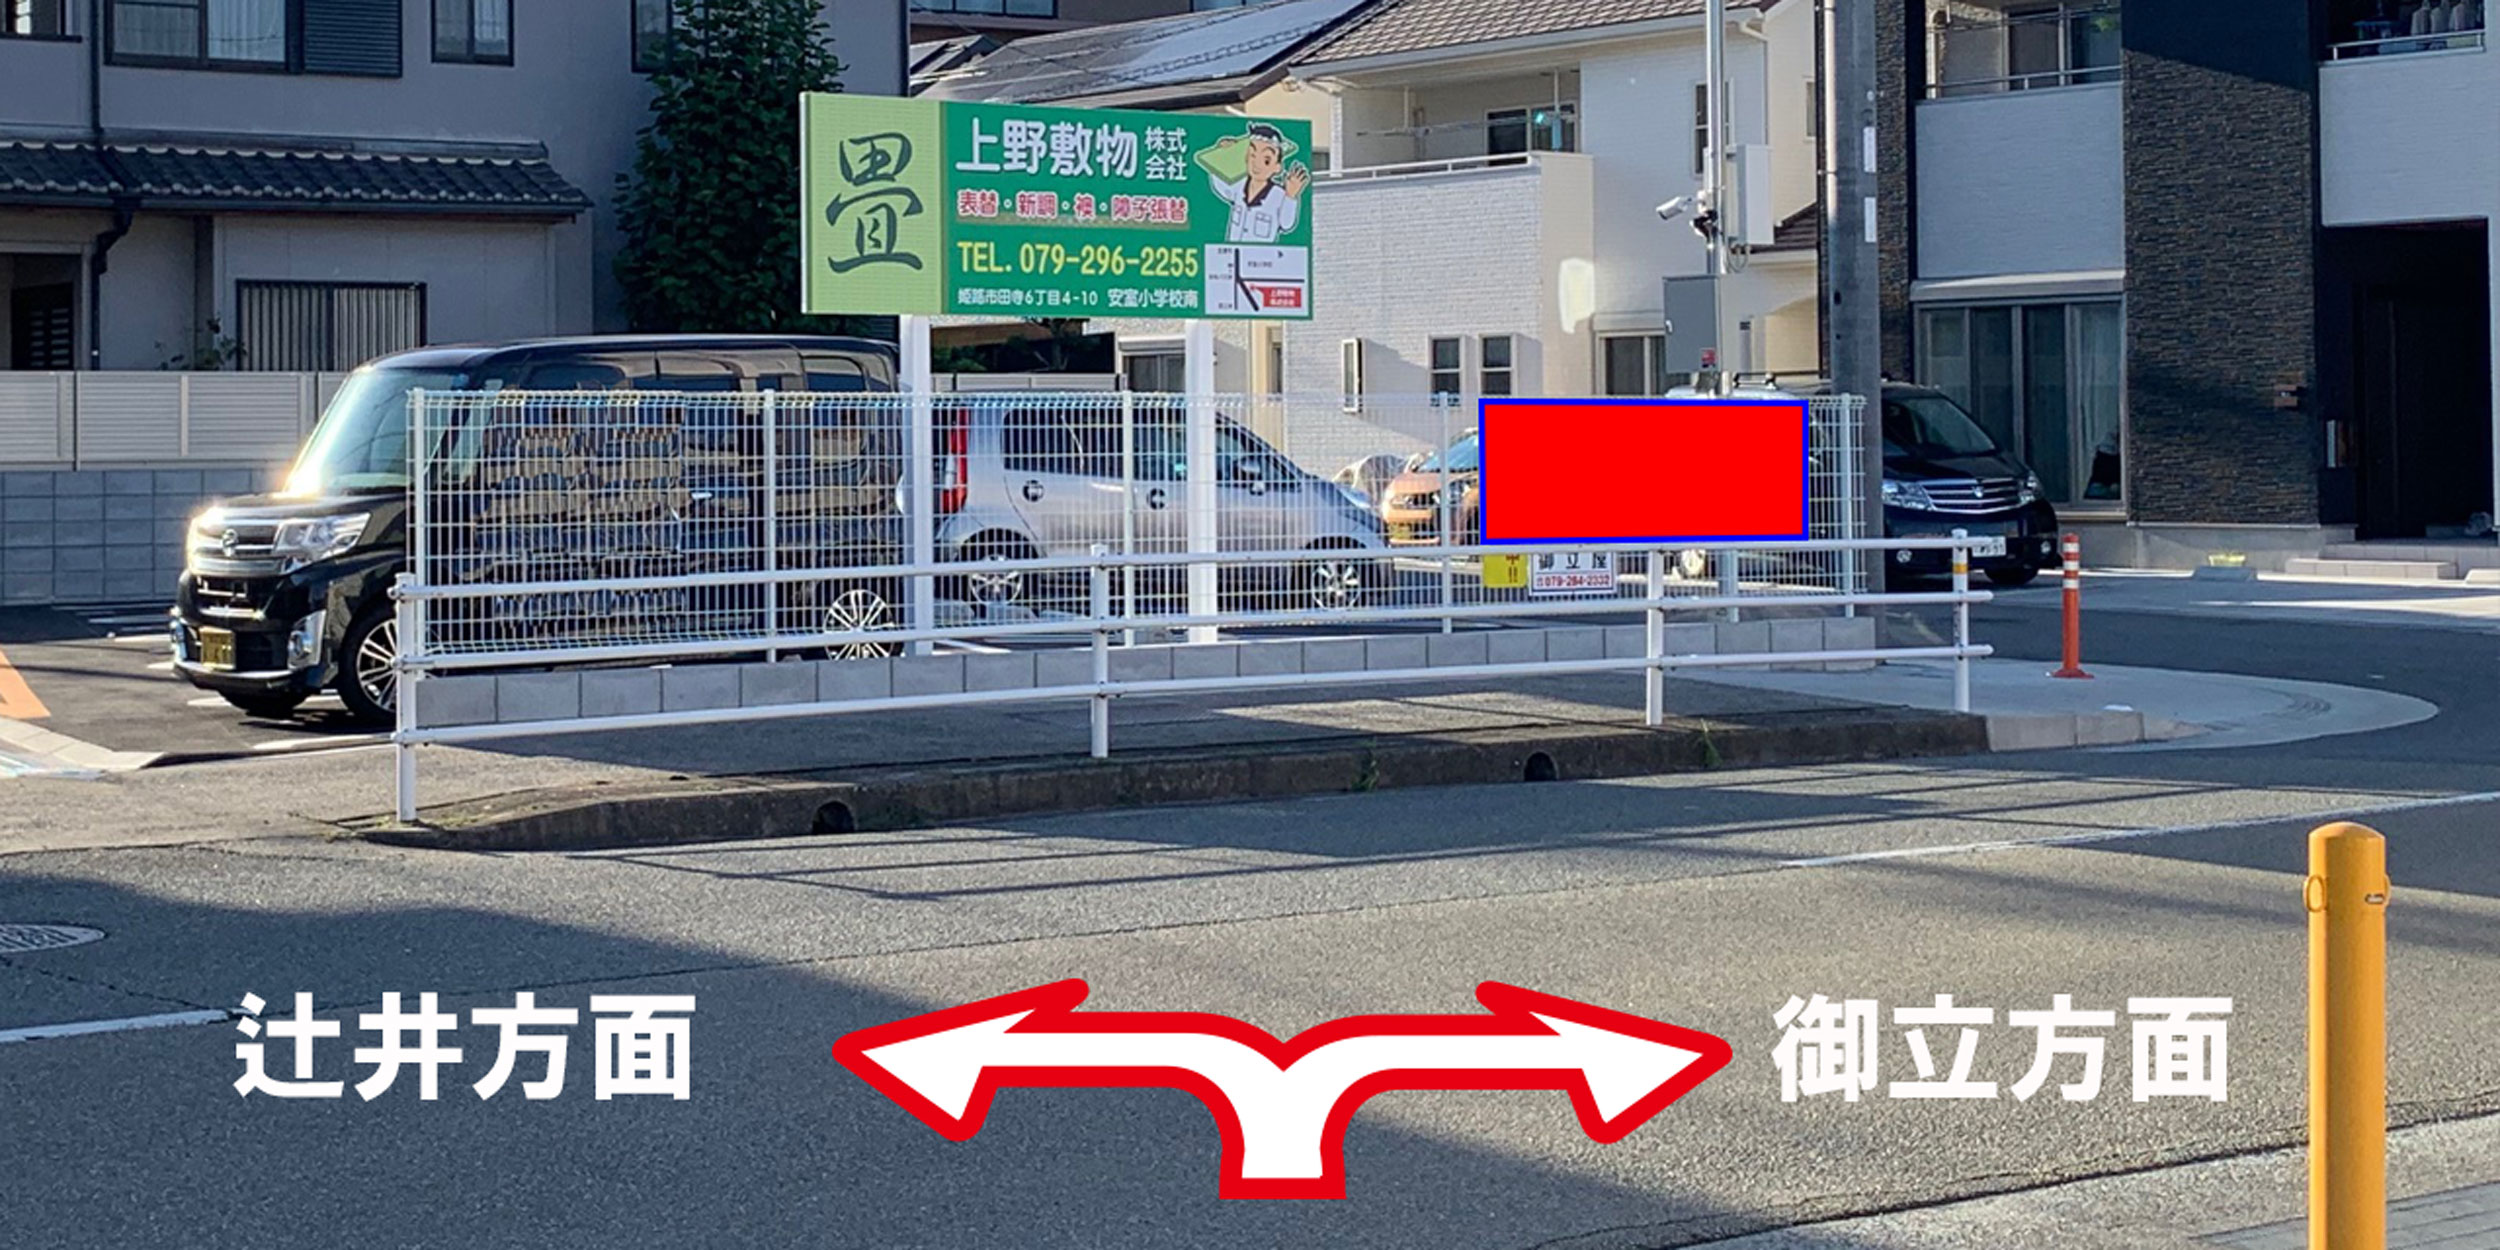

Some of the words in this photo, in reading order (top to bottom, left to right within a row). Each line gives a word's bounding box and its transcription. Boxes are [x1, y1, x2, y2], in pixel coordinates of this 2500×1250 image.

[955, 117, 1139, 178] 上野敷物
[1145, 126, 1187, 153] 株式
[1145, 154, 1188, 181] 会社
[957, 241, 1012, 272] TEL.
[1019, 242, 1199, 277] 079-296-2255
